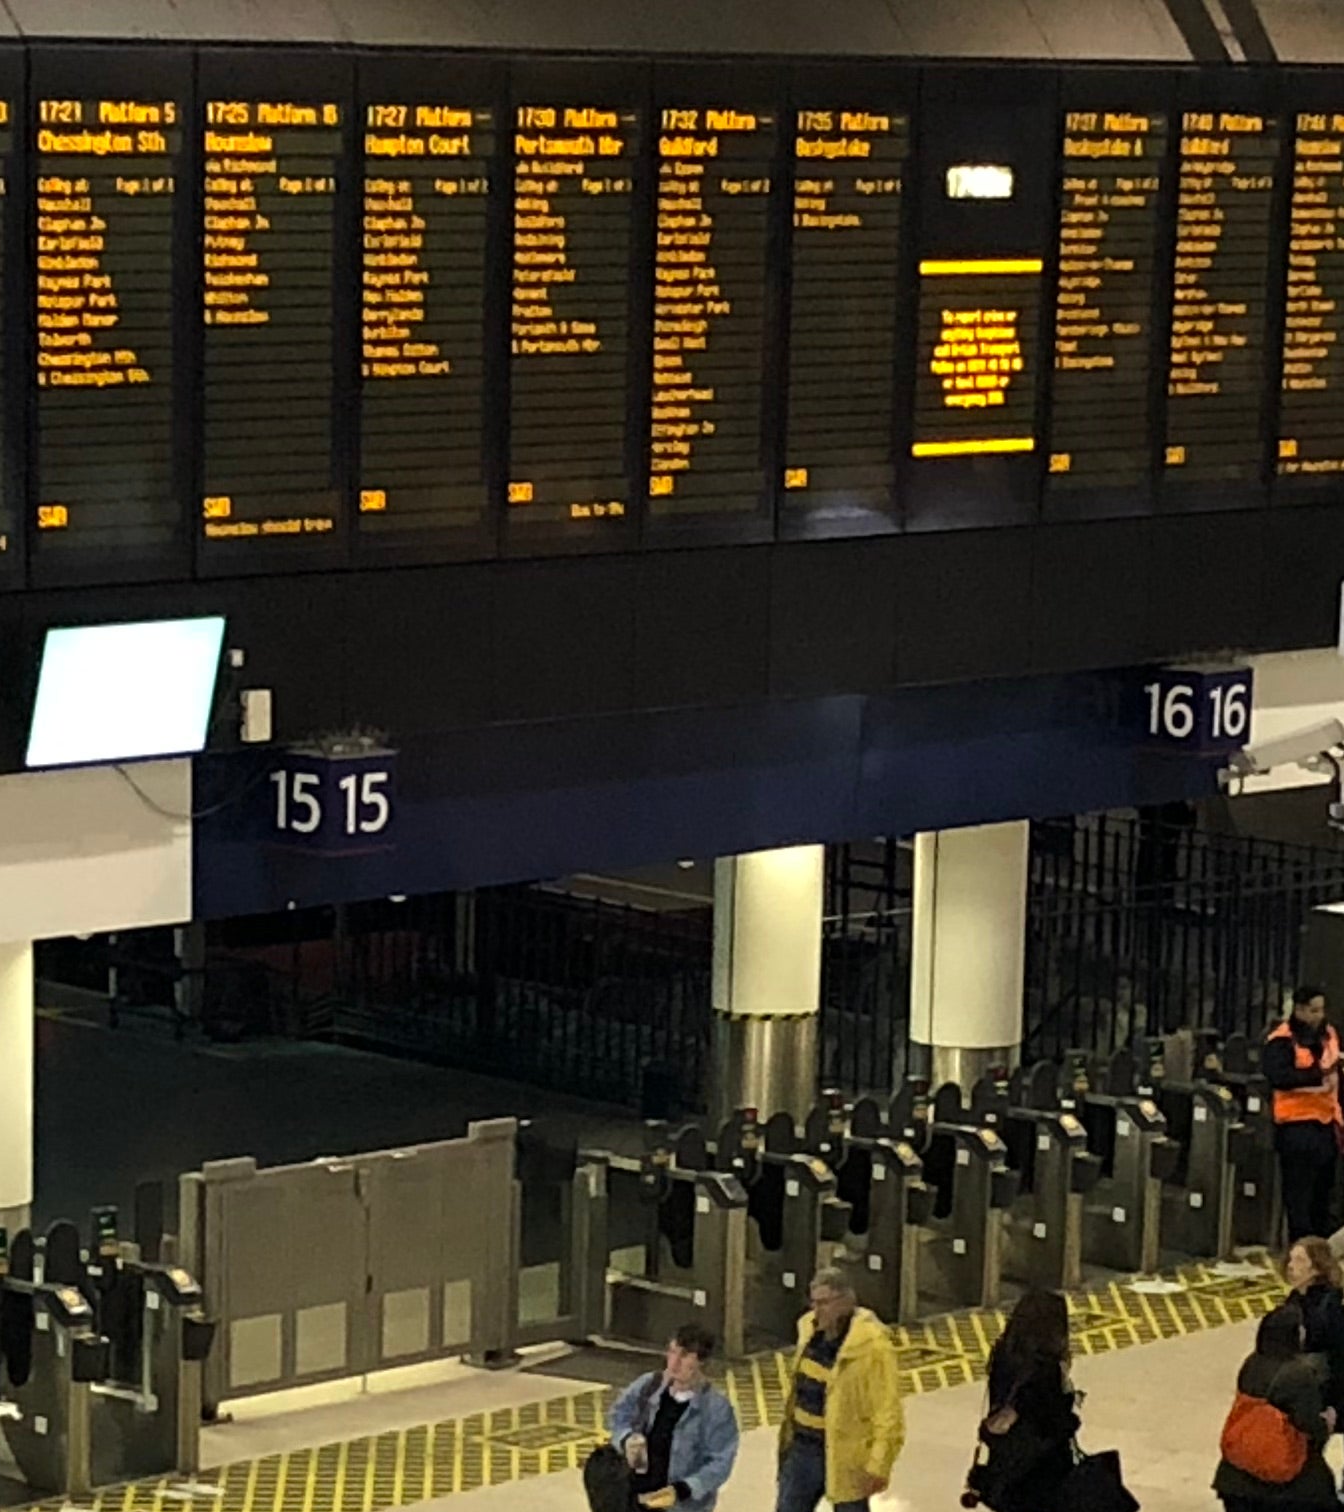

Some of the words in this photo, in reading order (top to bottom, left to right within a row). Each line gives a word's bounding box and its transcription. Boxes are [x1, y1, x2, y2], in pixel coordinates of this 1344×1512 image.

[41, 101, 81, 122] 17:21
[99, 102, 162, 123] Platform
[164, 103, 175, 123] 5
[1144, 683, 1194, 737] 16
[1208, 684, 1247, 738] 16
[272, 771, 320, 832] 15
[340, 772, 388, 833] 15
